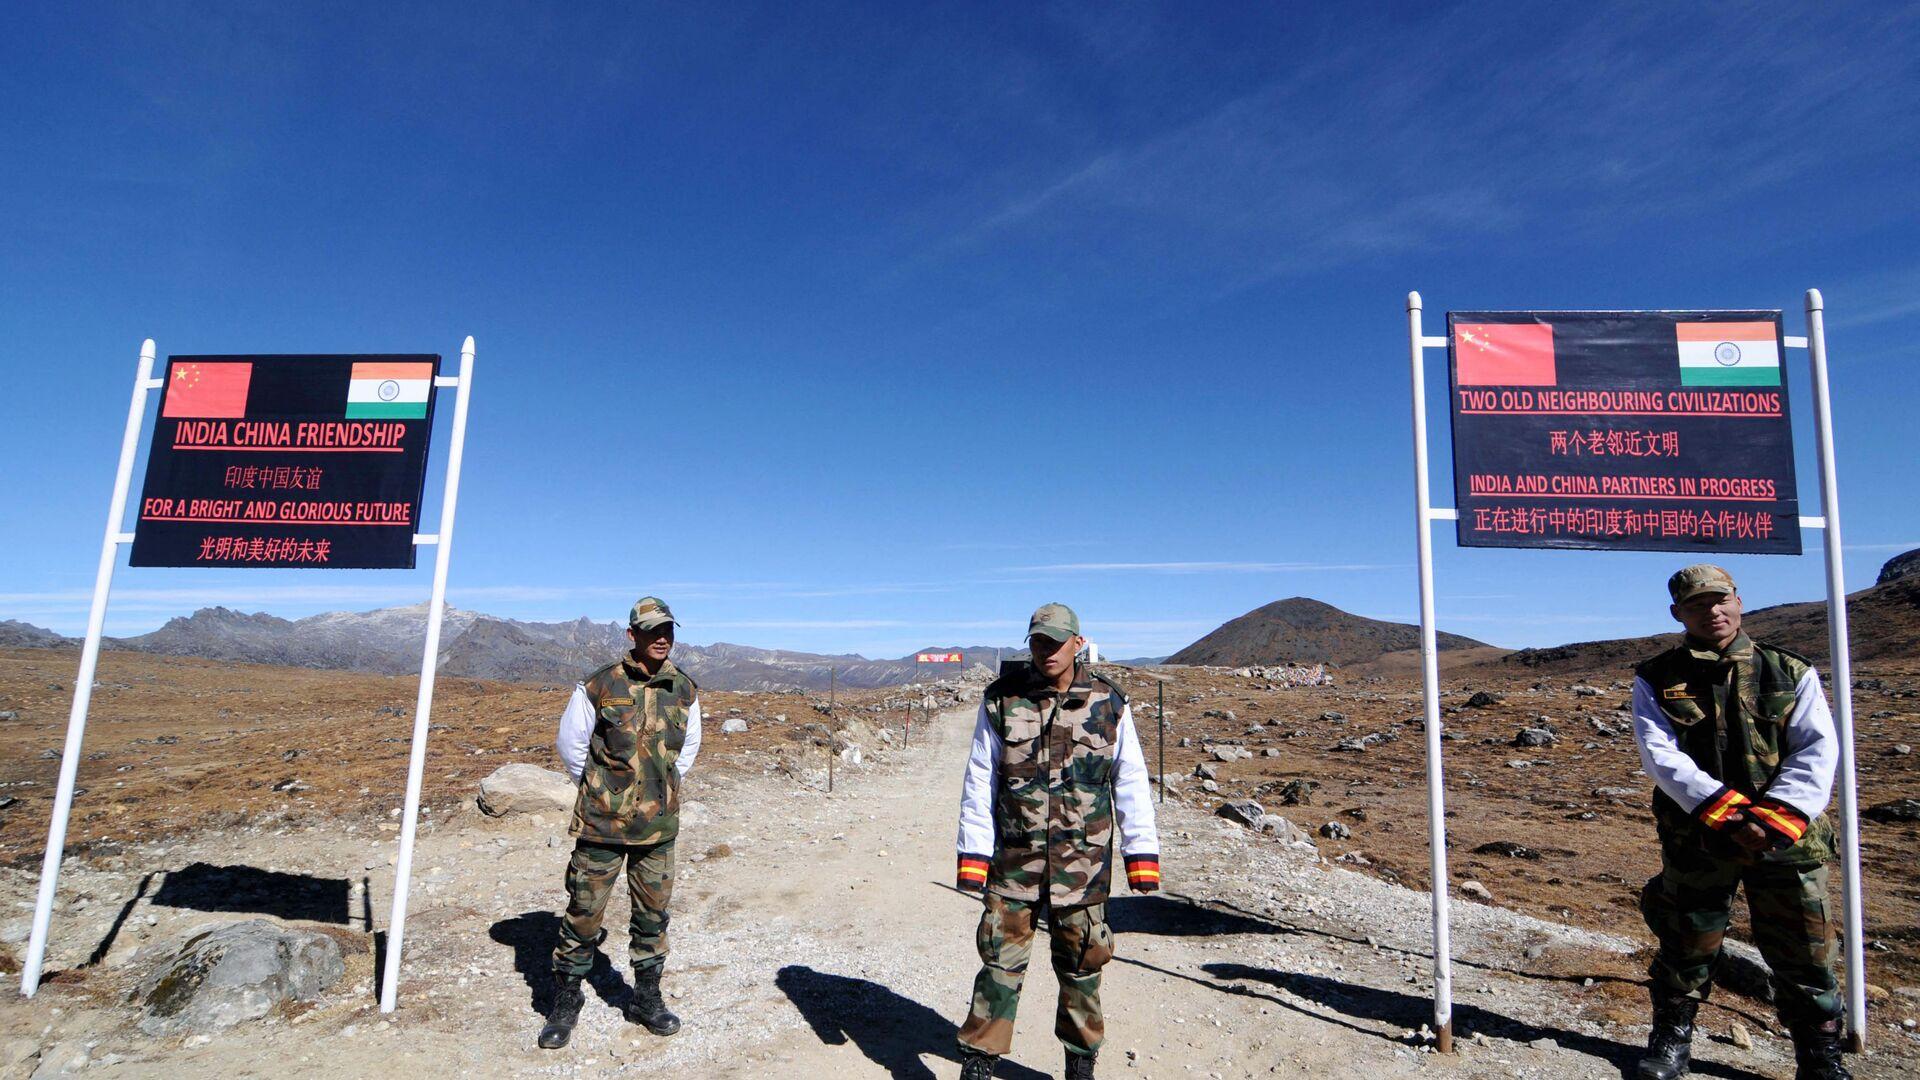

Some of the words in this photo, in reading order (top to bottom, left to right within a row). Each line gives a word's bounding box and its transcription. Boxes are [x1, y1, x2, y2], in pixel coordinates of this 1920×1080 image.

[1459, 390, 1497, 410] TWO
[1501, 391, 1534, 410] OLD
[1537, 391, 1663, 411] NEIGHBOURING
[1667, 392, 1781, 412] CIVILIZATIONS
[174, 421, 228, 446] INDIA
[233, 422, 291, 446] CHINA
[296, 422, 406, 448] FRIENDSHIP
[1549, 430, 1680, 457] 两个老邻近文明
[223, 465, 323, 490] 印度中国友谊
[1470, 474, 1511, 493] INDIA
[1515, 475, 1548, 493] AND
[1551, 475, 1599, 494] CHINA
[1602, 476, 1676, 495] PARTNERS
[1680, 477, 1697, 496] IN
[1700, 477, 1776, 497] PROGRESS
[143, 498, 173, 517] FOR
[174, 499, 186, 517] A
[189, 499, 242, 519] BRIGHT
[244, 501, 276, 519] AND
[279, 501, 353, 521] GLORIOUS
[355, 503, 411, 522] FUTURE
[1472, 507, 1774, 538] 正在进行中的印度和中国的合作伙伴
[196, 537, 331, 563] 光明和美好的未来
